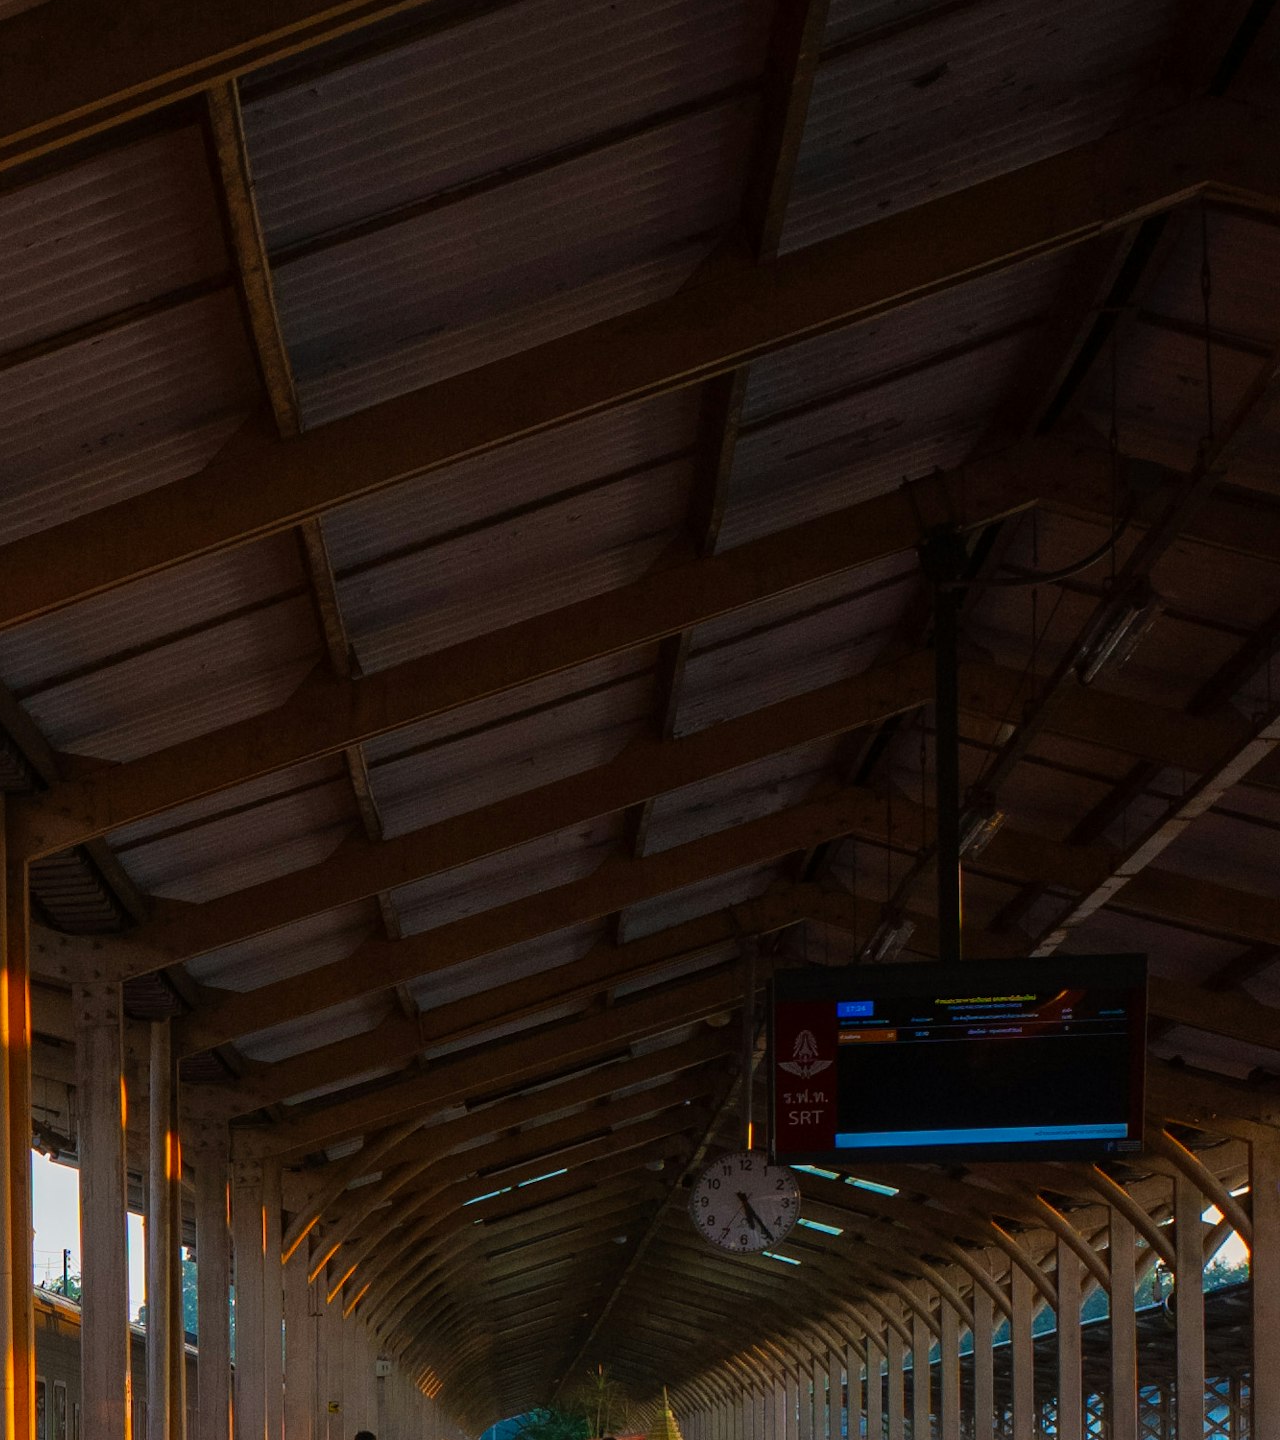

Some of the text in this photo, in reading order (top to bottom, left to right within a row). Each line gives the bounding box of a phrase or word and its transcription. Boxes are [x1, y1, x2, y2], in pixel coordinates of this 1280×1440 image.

[783, 1088, 829, 1104] ร.ฟ.ท.
[787, 1109, 825, 1125] SRT
[723, 1165, 732, 1176] 11
[740, 1159, 753, 1171] 12
[763, 1165, 768, 1177] 1
[707, 1178, 721, 1190] 10
[775, 1179, 785, 1190] 2
[700, 1196, 709, 1208] 9
[781, 1197, 790, 1209] 3
[706, 1214, 715, 1226] 8
[773, 1215, 782, 1227] 4
[722, 1227, 731, 1240] 7
[740, 1233, 749, 1245] 6
